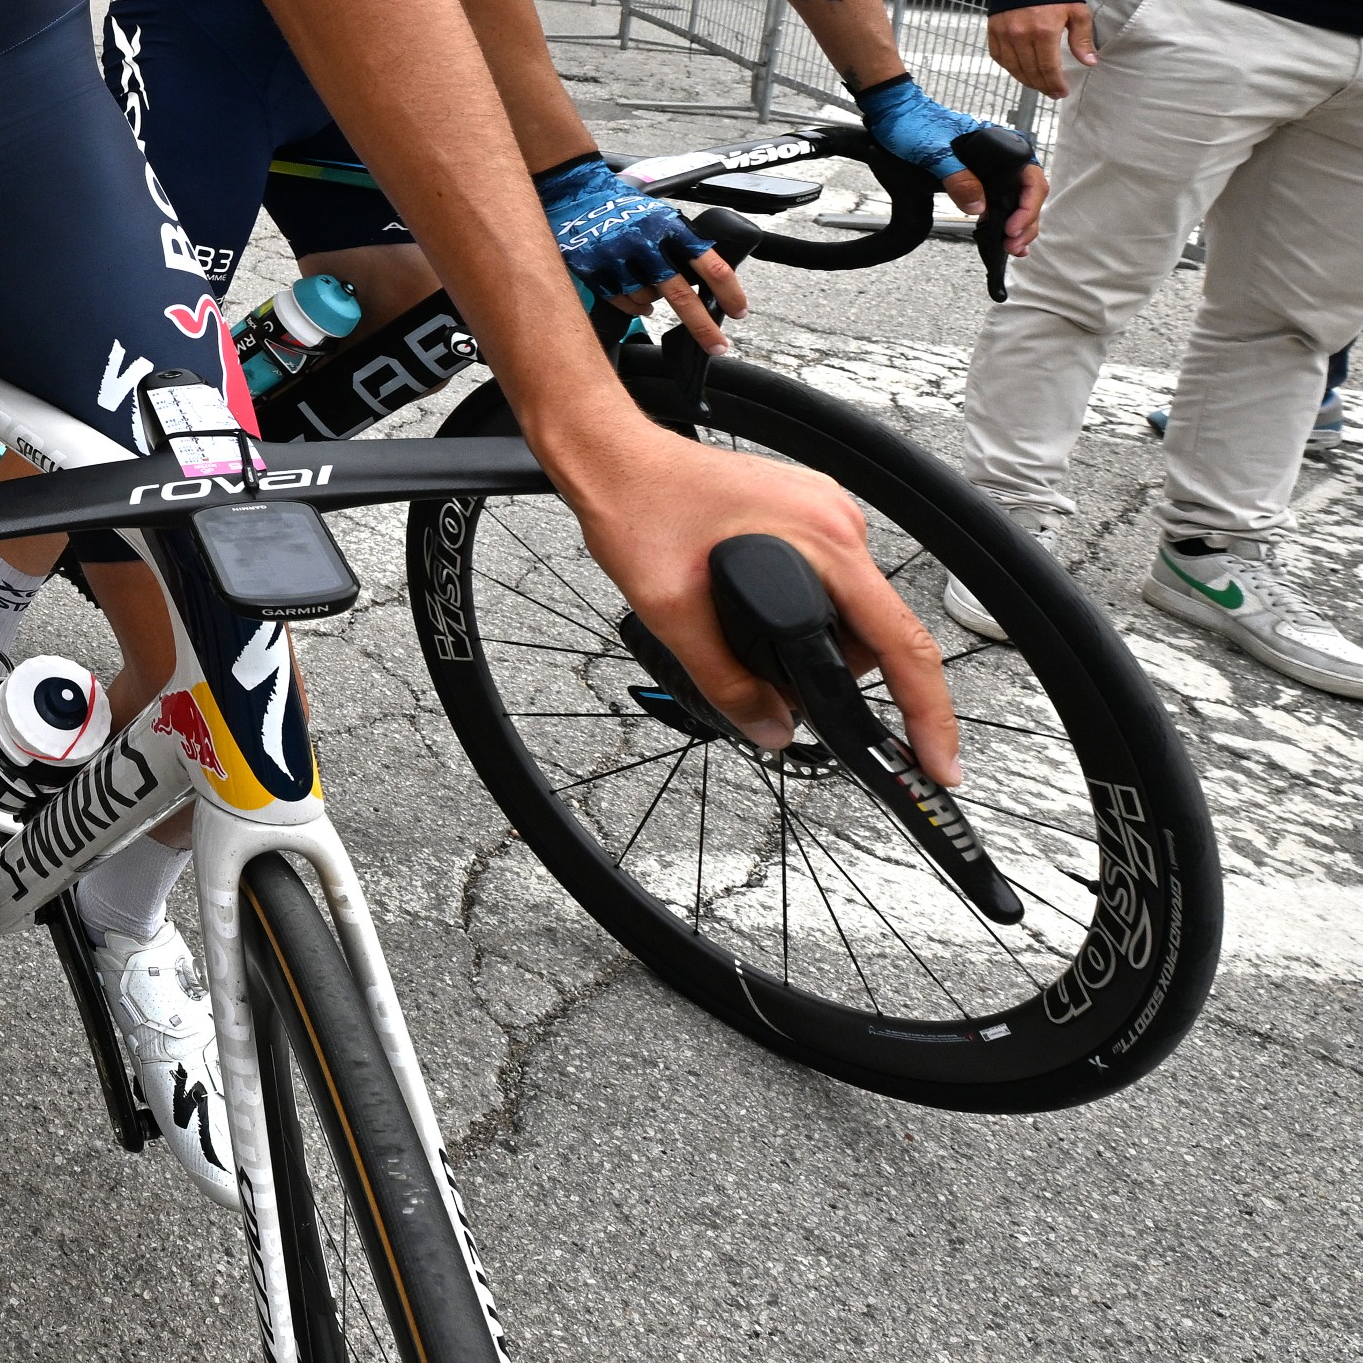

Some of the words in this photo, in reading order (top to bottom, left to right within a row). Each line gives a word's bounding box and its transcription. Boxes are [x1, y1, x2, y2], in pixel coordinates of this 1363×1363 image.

[559, 201, 667, 253] ASTANA
[128, 464, 334, 506] roval
[261, 604, 330, 617] GARMIN
[0, 723, 160, 903] S-WORKS
[867, 736, 984, 864] SRAM
